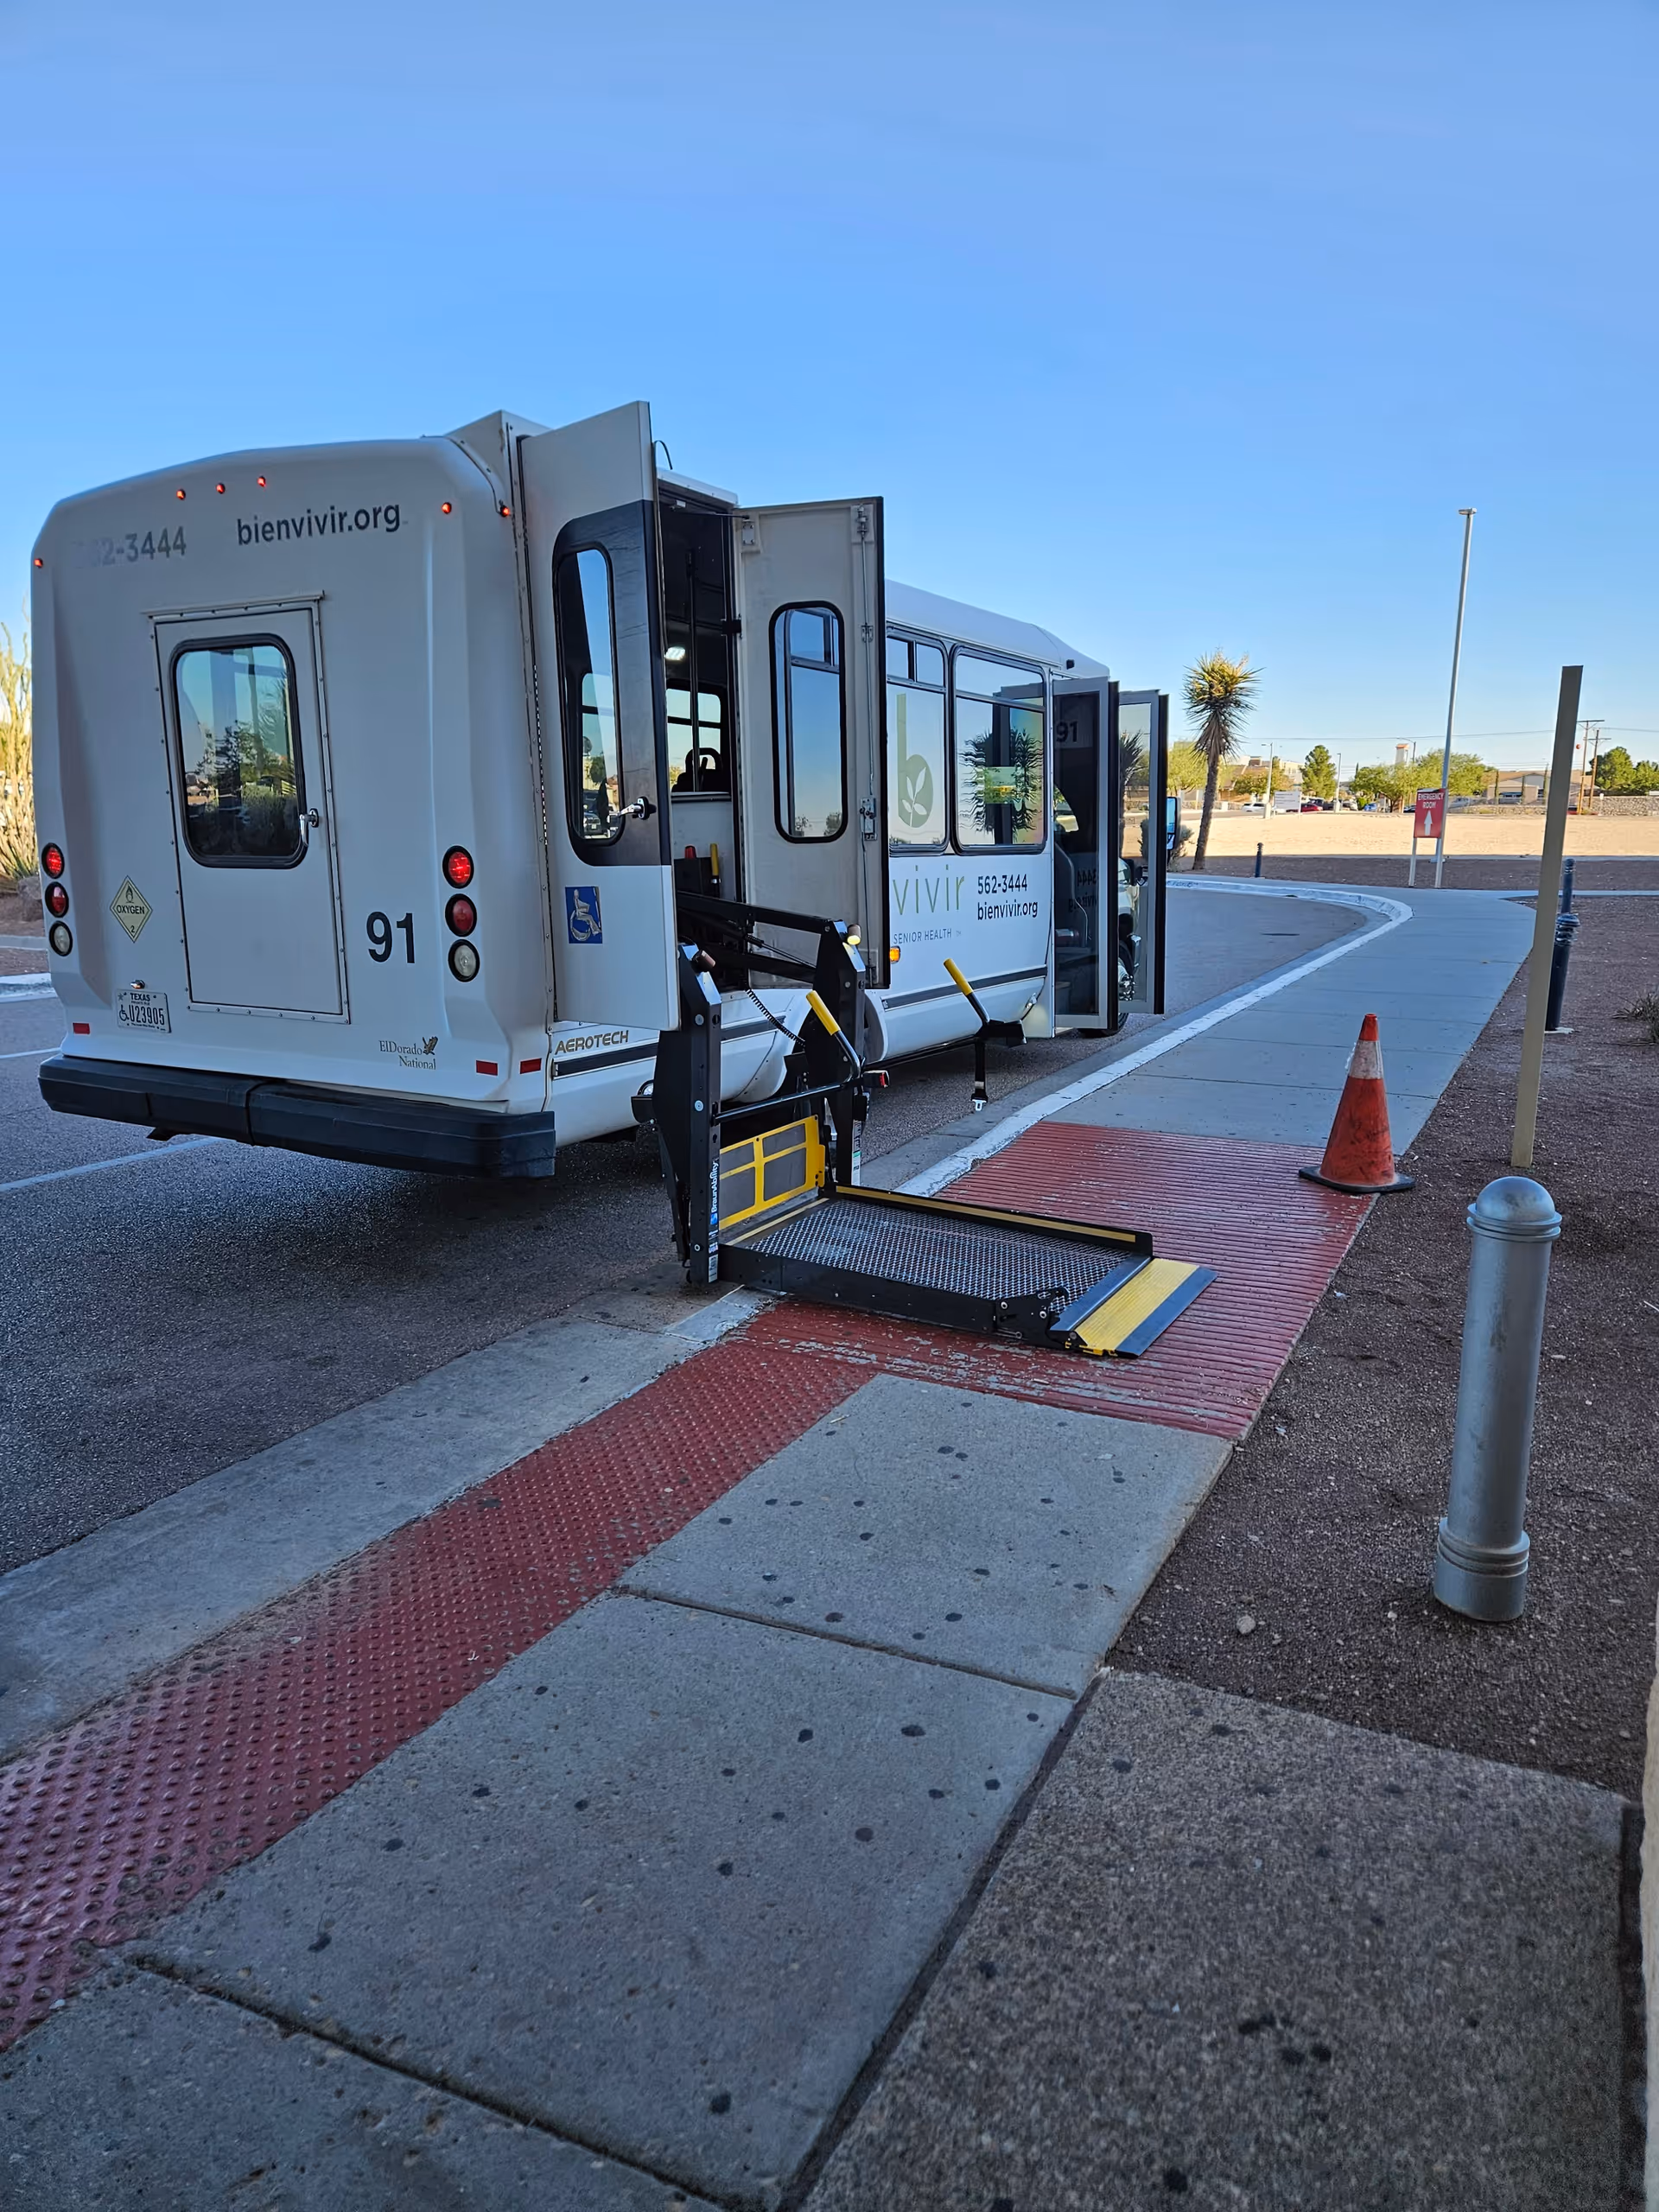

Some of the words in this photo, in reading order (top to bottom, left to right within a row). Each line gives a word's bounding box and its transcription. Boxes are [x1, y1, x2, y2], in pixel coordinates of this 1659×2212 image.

[238, 505, 400, 546] bienvivir.org
[1056, 721, 1077, 743] 91
[1418, 792, 1444, 801] EMERGENCY
[893, 864, 964, 915] vivir
[977, 874, 1028, 895] 562-3444
[116, 905, 145, 915] OXYGEN
[977, 899, 1038, 920] bienvivir.org
[130, 925, 136, 933] 2
[366, 911, 416, 963] 91
[893, 931, 922, 944] SENIOR
[925, 928, 952, 941] HEALTH
[130, 993, 150, 1001] TEXAS
[129, 1004, 165, 1026] U23905
[378, 1039, 423, 1055] ElDorado
[555, 1030, 629, 1055] AEROTECH
[398, 1055, 436, 1070] National
[710, 1160, 719, 1213] BraunAbility
